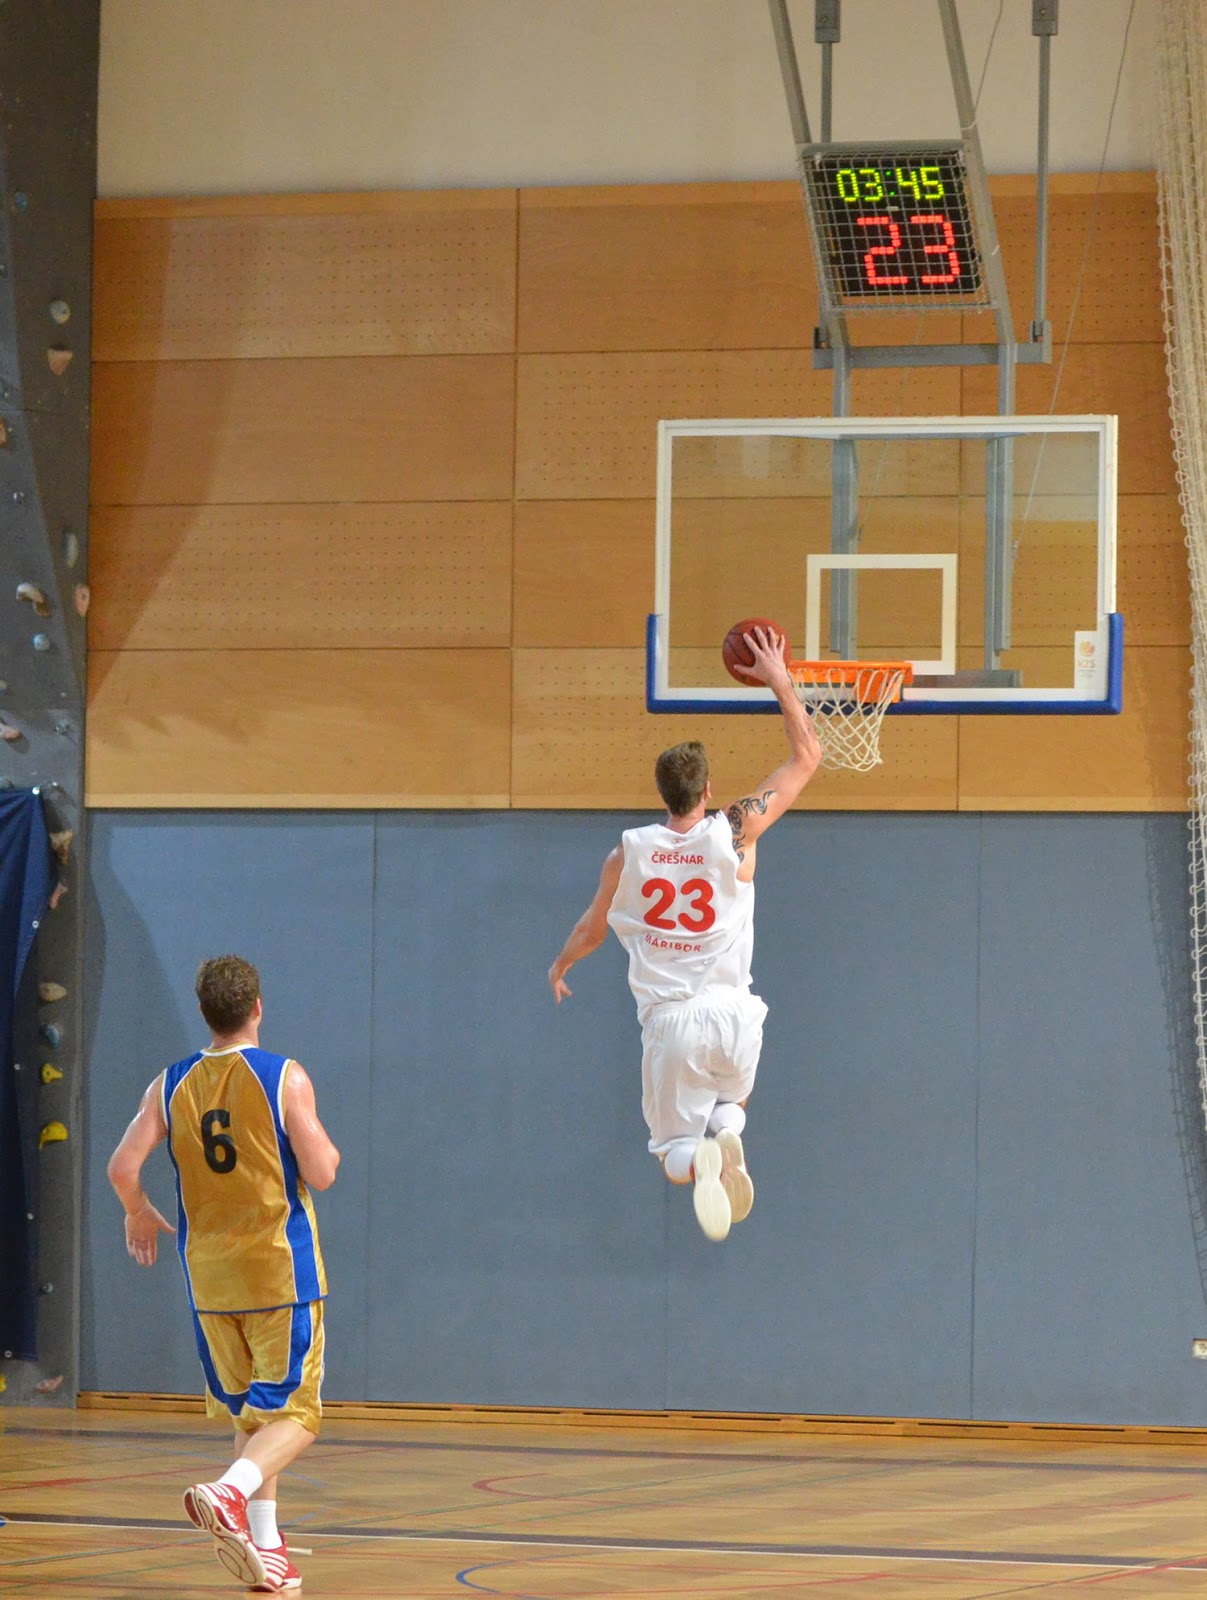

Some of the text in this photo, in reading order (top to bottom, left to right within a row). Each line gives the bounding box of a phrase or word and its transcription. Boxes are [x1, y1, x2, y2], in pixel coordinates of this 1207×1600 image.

[836, 166, 944, 202] 03:45
[857, 215, 961, 285] 23
[651, 851, 704, 865] ČREŠNAR
[641, 877, 716, 933] 23
[201, 1109, 237, 1174] 6
